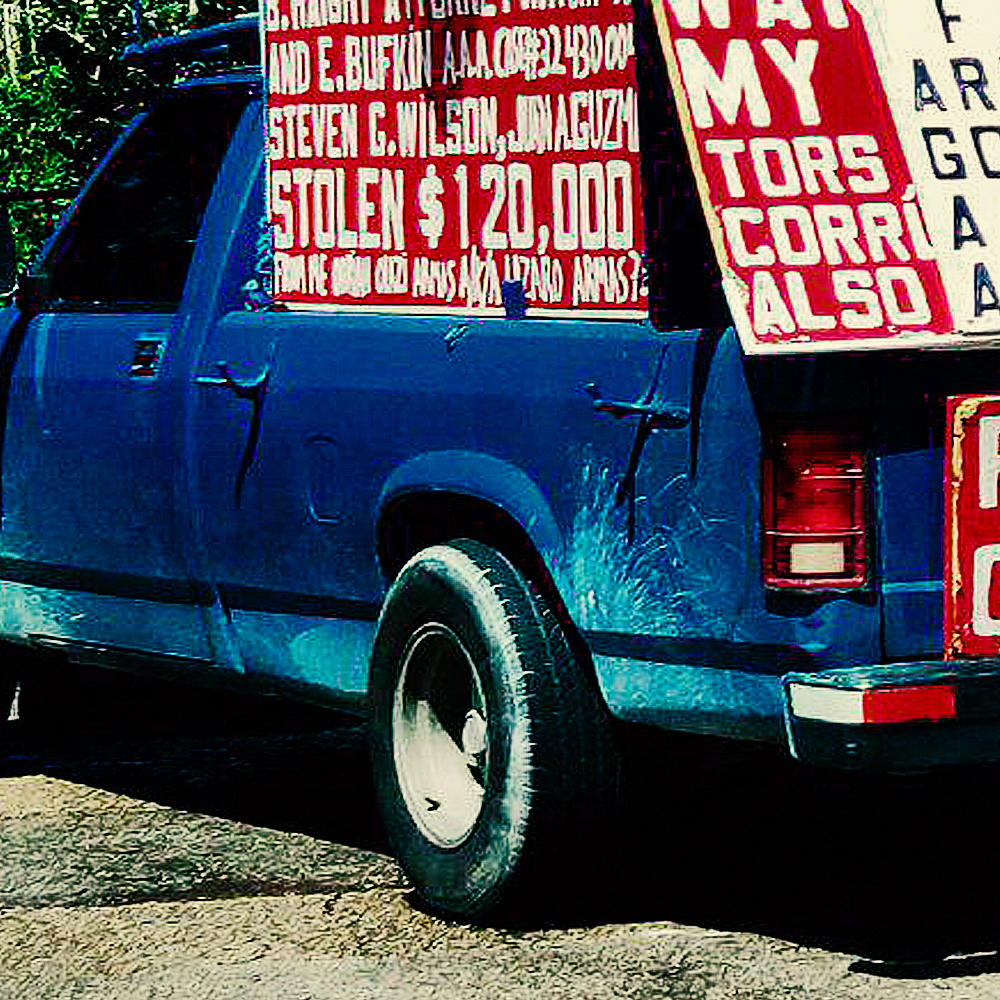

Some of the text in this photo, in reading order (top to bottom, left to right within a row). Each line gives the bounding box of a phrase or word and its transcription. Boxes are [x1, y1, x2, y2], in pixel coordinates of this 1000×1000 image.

[674, 37, 822, 128] MY
[268, 103, 359, 160] STEVEN
[704, 134, 891, 198] TORS
[271, 167, 406, 251] STOLEN
[953, 194, 987, 250] A
[753, 265, 933, 333] ALSO
